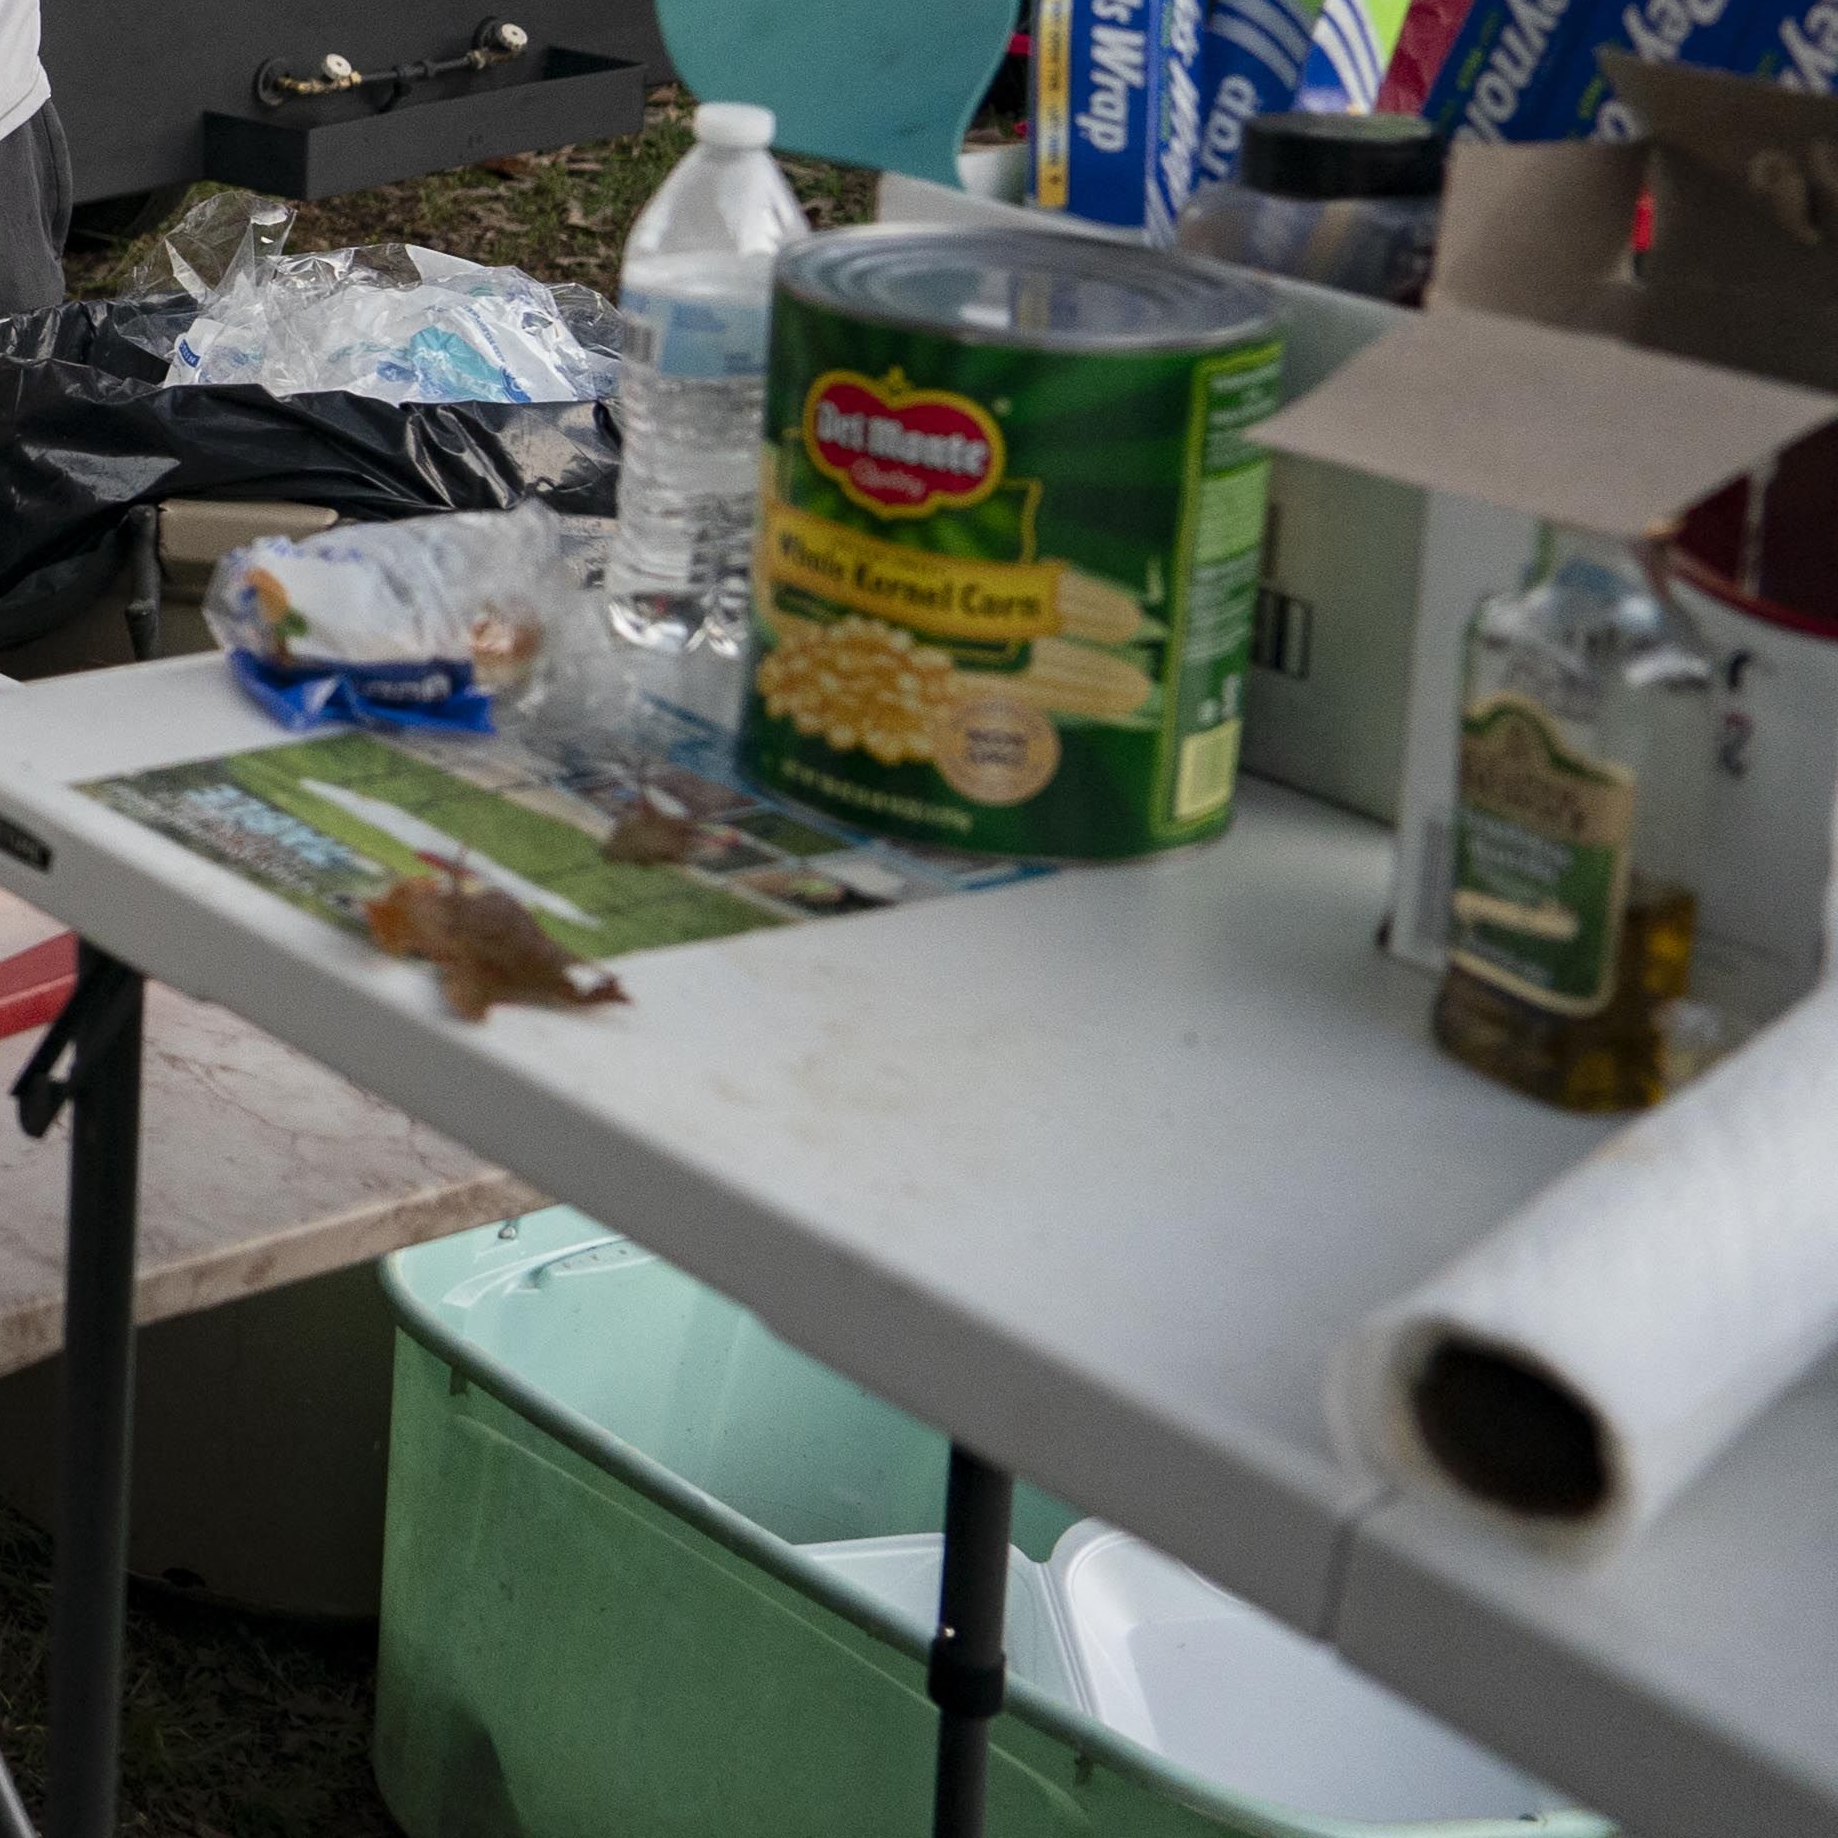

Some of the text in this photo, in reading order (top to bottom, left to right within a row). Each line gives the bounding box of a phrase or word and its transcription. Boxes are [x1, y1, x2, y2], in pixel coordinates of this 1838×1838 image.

[1076, 26, 1145, 153] Wrap
[1198, 72, 1261, 182] rap
[817, 399, 990, 478] Del Monte
[855, 562, 955, 608] Kernel
[961, 582, 1043, 618] Corn
